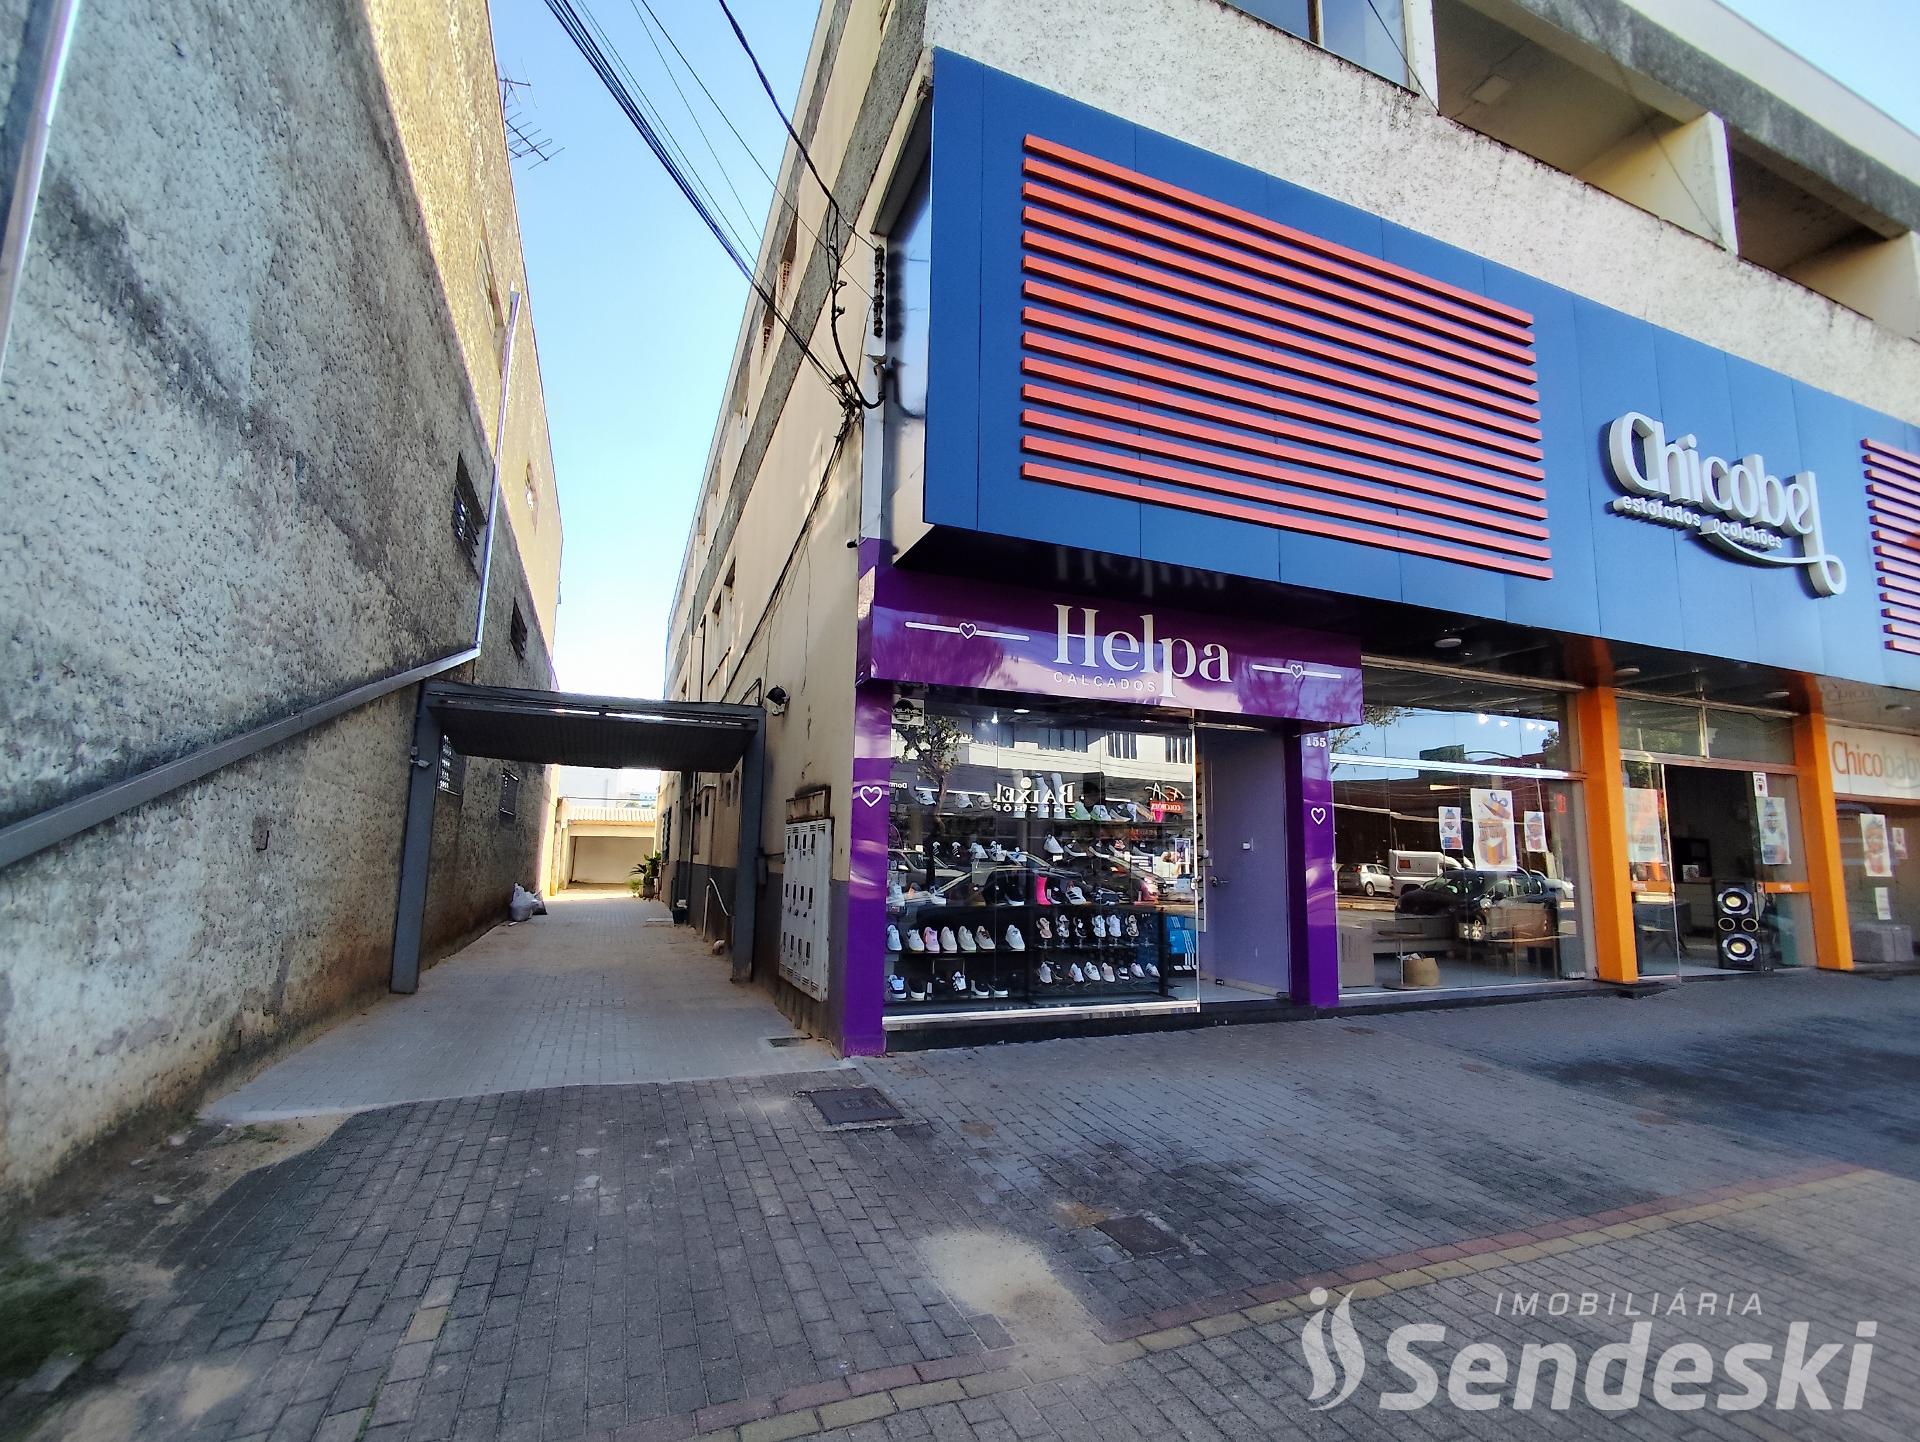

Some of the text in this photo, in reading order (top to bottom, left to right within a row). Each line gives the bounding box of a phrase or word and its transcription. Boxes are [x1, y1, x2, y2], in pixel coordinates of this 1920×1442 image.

[1613, 495, 1701, 527] estofados
[1721, 521, 1783, 549] colchões
[1053, 603, 1232, 697] Helpa
[1305, 736, 1327, 748] 155
[1831, 740, 1920, 781] Chicobab
